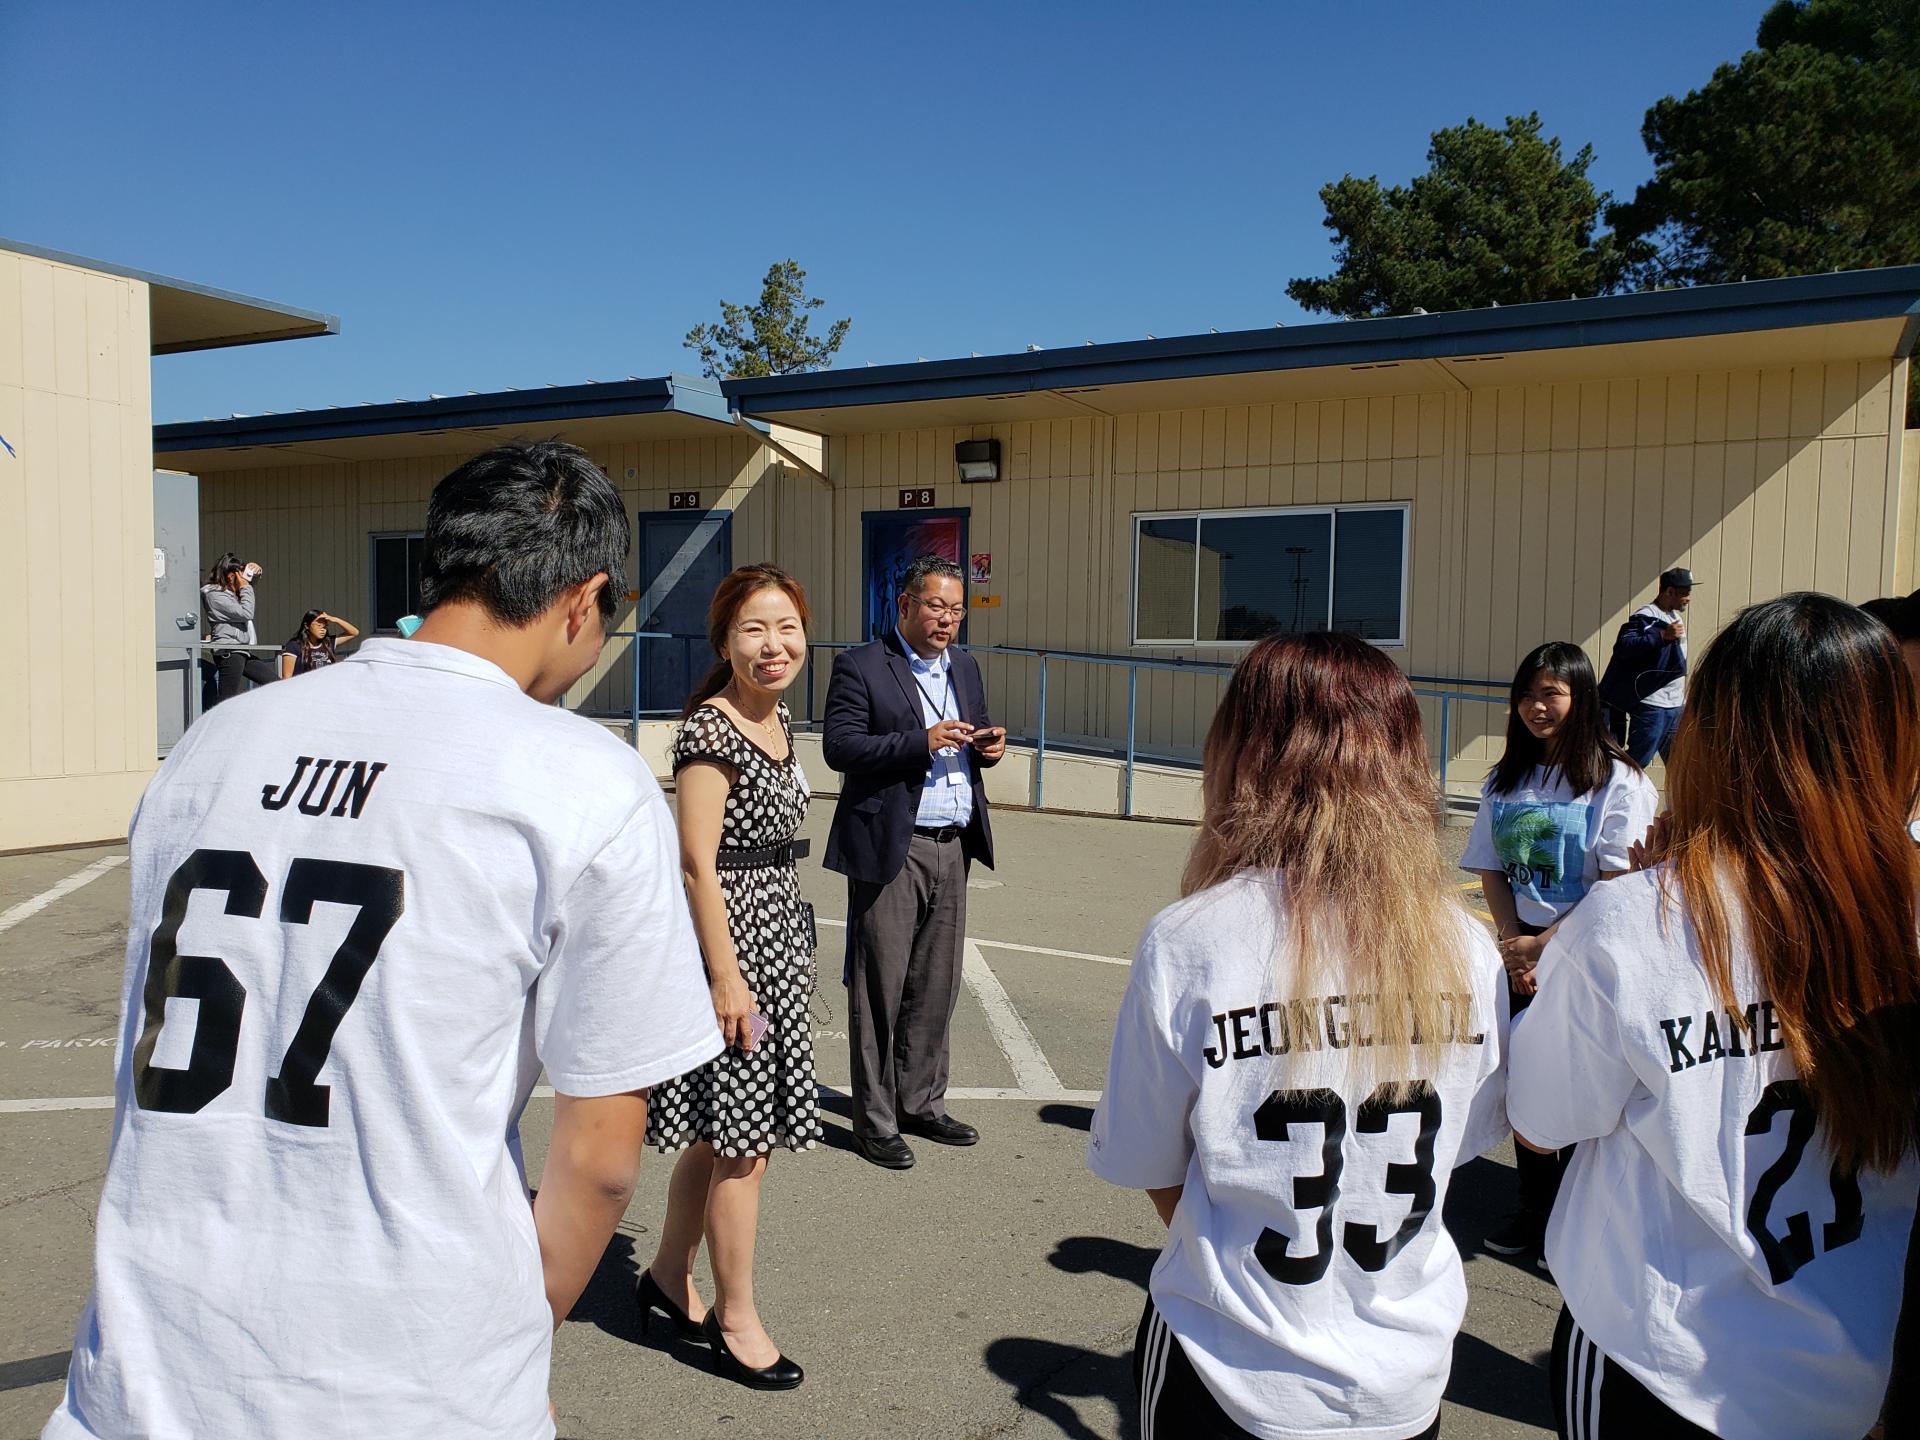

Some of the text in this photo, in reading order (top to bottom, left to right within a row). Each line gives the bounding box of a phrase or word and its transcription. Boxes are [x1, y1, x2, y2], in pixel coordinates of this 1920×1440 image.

[261, 755, 388, 819] JUN
[133, 848, 405, 1128] 67
[1203, 992, 1485, 1070] JEONGCOL
[1253, 1079, 1443, 1286] 33
